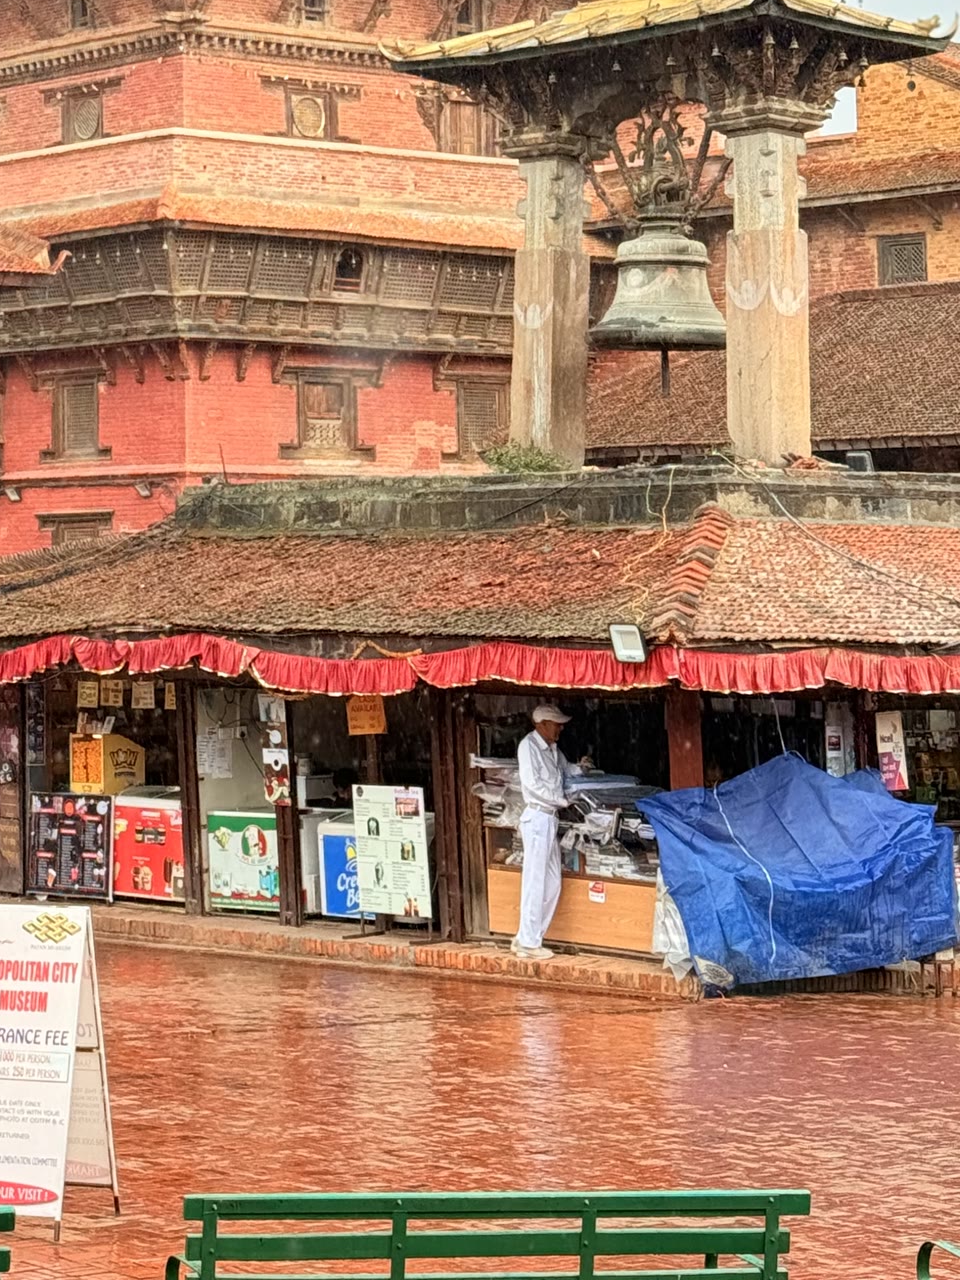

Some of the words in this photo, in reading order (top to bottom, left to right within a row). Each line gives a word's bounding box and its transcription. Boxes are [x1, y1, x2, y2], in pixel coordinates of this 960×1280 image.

[880, 734, 893, 743] Ncell
[52, 962, 78, 983] CITY
[45, 1030, 69, 1046] FEE
[0, 1051, 14, 1062] 1000
[16, 1053, 26, 1062] PER
[12, 1066, 24, 1077] 250
[26, 1068, 36, 1078] PER
[37, 1069, 60, 1079] PERSON
[18, 1188, 42, 1201] VISIT
